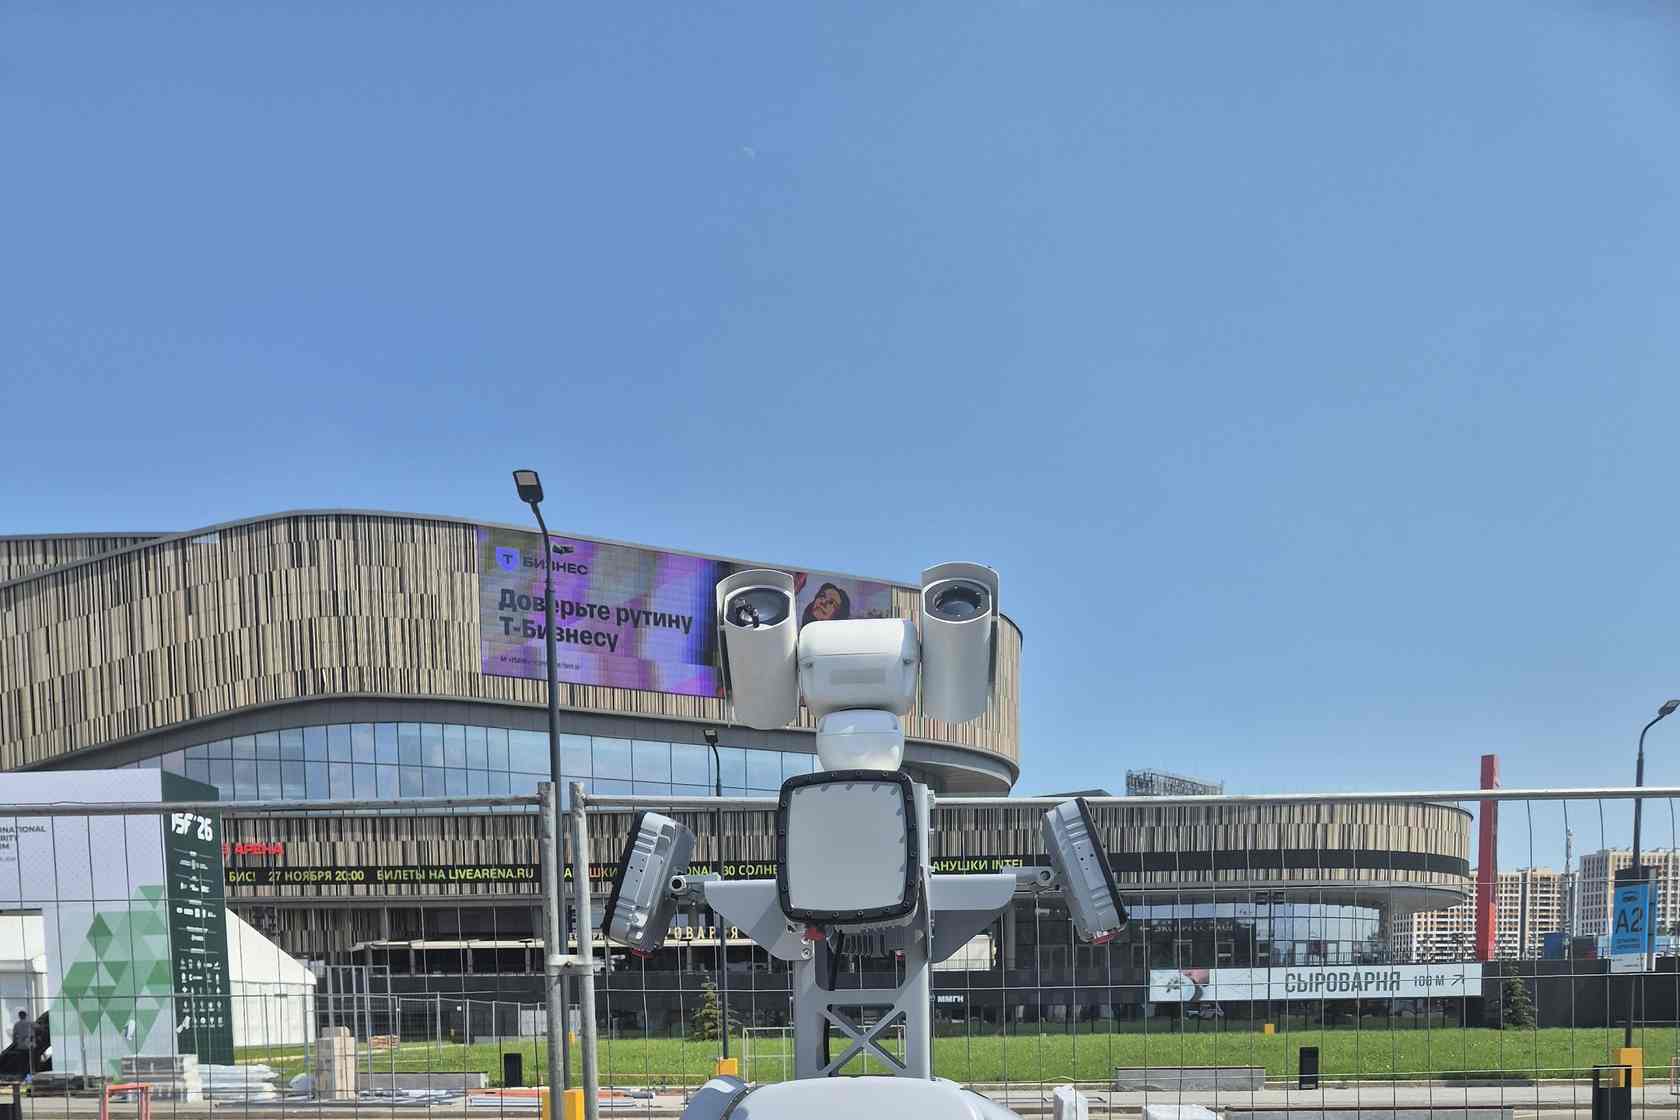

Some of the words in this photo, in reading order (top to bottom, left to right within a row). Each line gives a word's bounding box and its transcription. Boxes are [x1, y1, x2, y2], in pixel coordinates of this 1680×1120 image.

[522, 556, 589, 575] БИЗНЕС
[616, 606, 693, 634] рутину
[500, 616, 618, 652] Т-Бизнесу
[0, 825, 46, 833] NATIONAL
[229, 871, 256, 882] БИС!
[268, 871, 281, 881] 27
[285, 871, 332, 881] НОЯБРЯ
[335, 870, 364, 881] 20:00
[377, 869, 425, 881] БИЛЕТЫ
[429, 869, 446, 880] НА
[449, 868, 534, 880] LIVEARENA.RU
[664, 926, 739, 939] ОВАРЯ
[1284, 971, 1401, 994] СЫРОВАРНЯ
